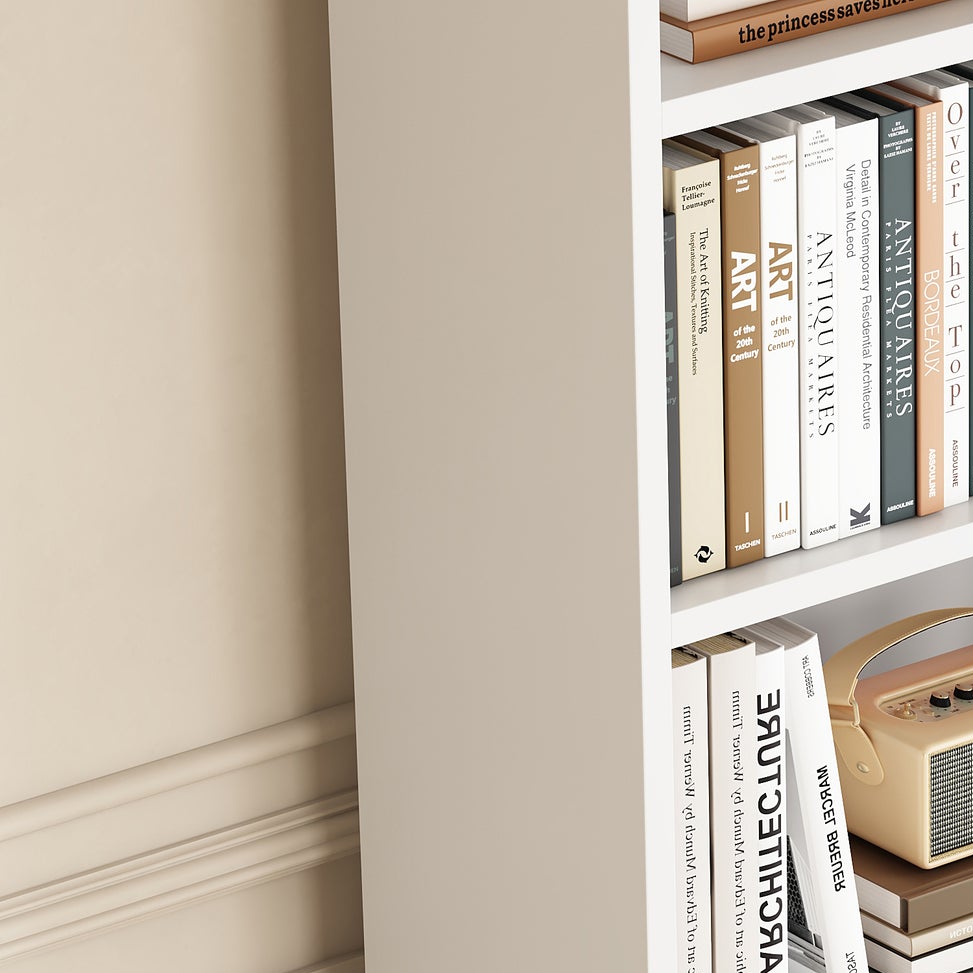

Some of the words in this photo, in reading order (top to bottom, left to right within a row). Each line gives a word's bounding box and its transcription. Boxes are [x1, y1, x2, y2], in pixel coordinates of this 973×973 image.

[738, 24, 766, 44] the
[767, 8, 836, 42] princess
[947, 102, 963, 199] Over
[681, 181, 712, 193] Françoise
[843, 163, 856, 209] Virginia
[861, 159, 871, 193] Detail
[681, 198, 715, 211] Loumagne
[682, 191, 705, 202] Tellier-
[861, 196, 872, 207] in
[700, 228, 709, 251] The
[846, 211, 856, 258] McLeod
[700, 253, 709, 272] Art
[860, 210, 872, 292] Contemporary
[769, 242, 793, 301] ART
[950, 231, 961, 299] the
[700, 273, 709, 285] of
[731, 251, 757, 312] ART
[698, 286, 711, 335] Knitting
[770, 318, 779, 326] of
[779, 315, 792, 324] the
[891, 218, 913, 416] ANTIQUAIRES
[733, 328, 743, 337] of
[742, 324, 756, 334] the
[773, 328, 790, 338] 20th
[813, 232, 835, 436] ANTIQUAIRES
[862, 295, 872, 360] Residential
[923, 269, 940, 377] BORDEAUX
[736, 337, 753, 349] 20th
[767, 339, 796, 352] Century
[730, 349, 759, 363] Century
[948, 325, 963, 406] Top
[862, 362, 872, 430] Architecture
[886, 500, 914, 512] ASSOULINE
[771, 529, 797, 541] TASCHEN
[809, 524, 837, 536] ASSOULINE
[734, 539, 761, 552] TASCHEN
